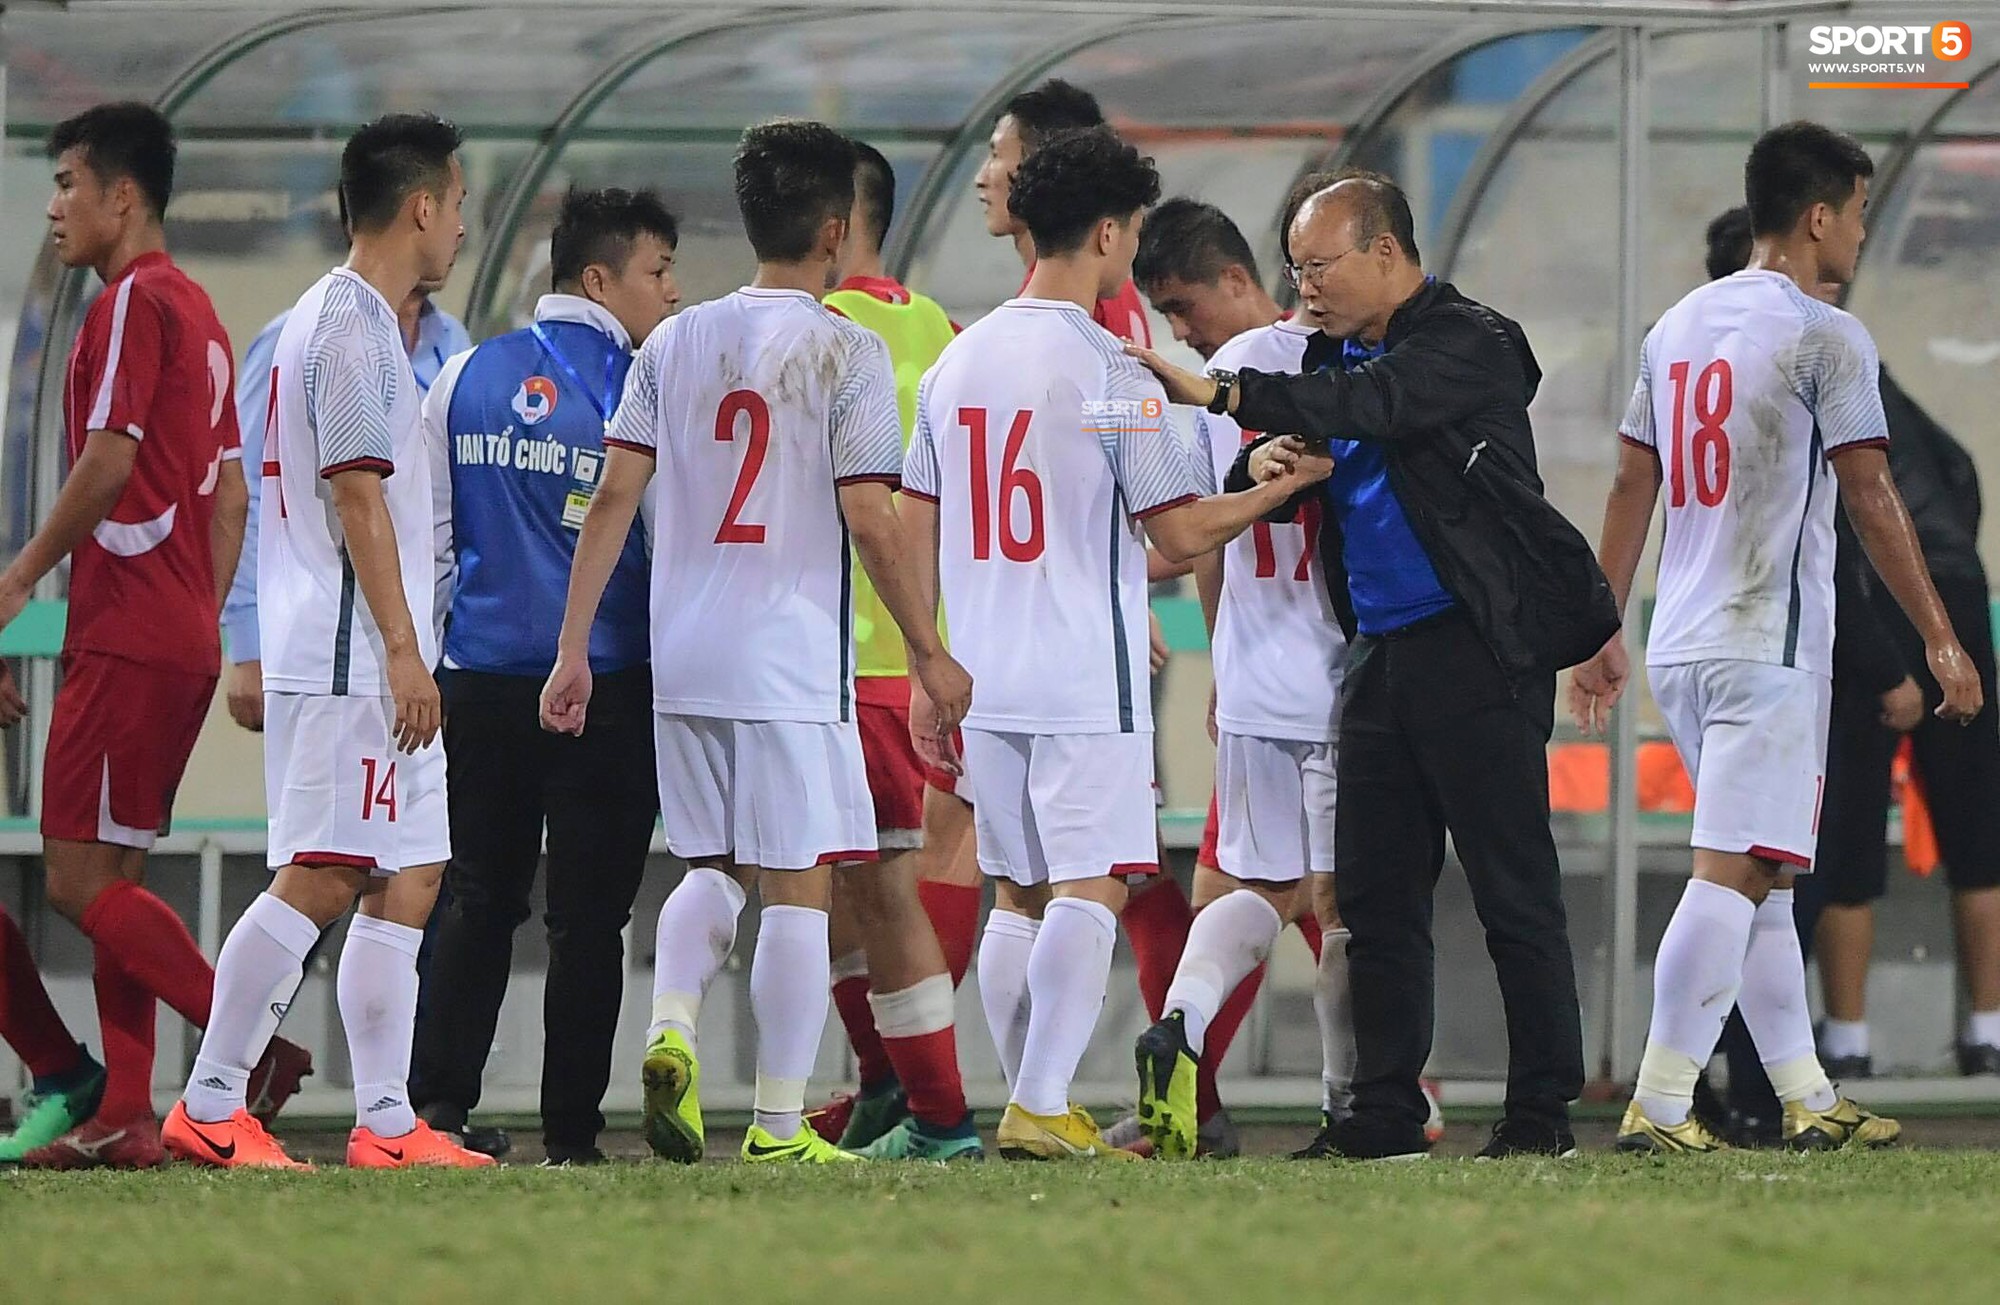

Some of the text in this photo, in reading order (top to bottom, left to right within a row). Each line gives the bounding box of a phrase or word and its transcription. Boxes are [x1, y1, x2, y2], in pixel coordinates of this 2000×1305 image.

[515, 433, 566, 475] CHỨC
[713, 388, 770, 545] 2
[957, 407, 1046, 563] 16
[1669, 358, 1732, 508] 18
[361, 757, 396, 822] 14
